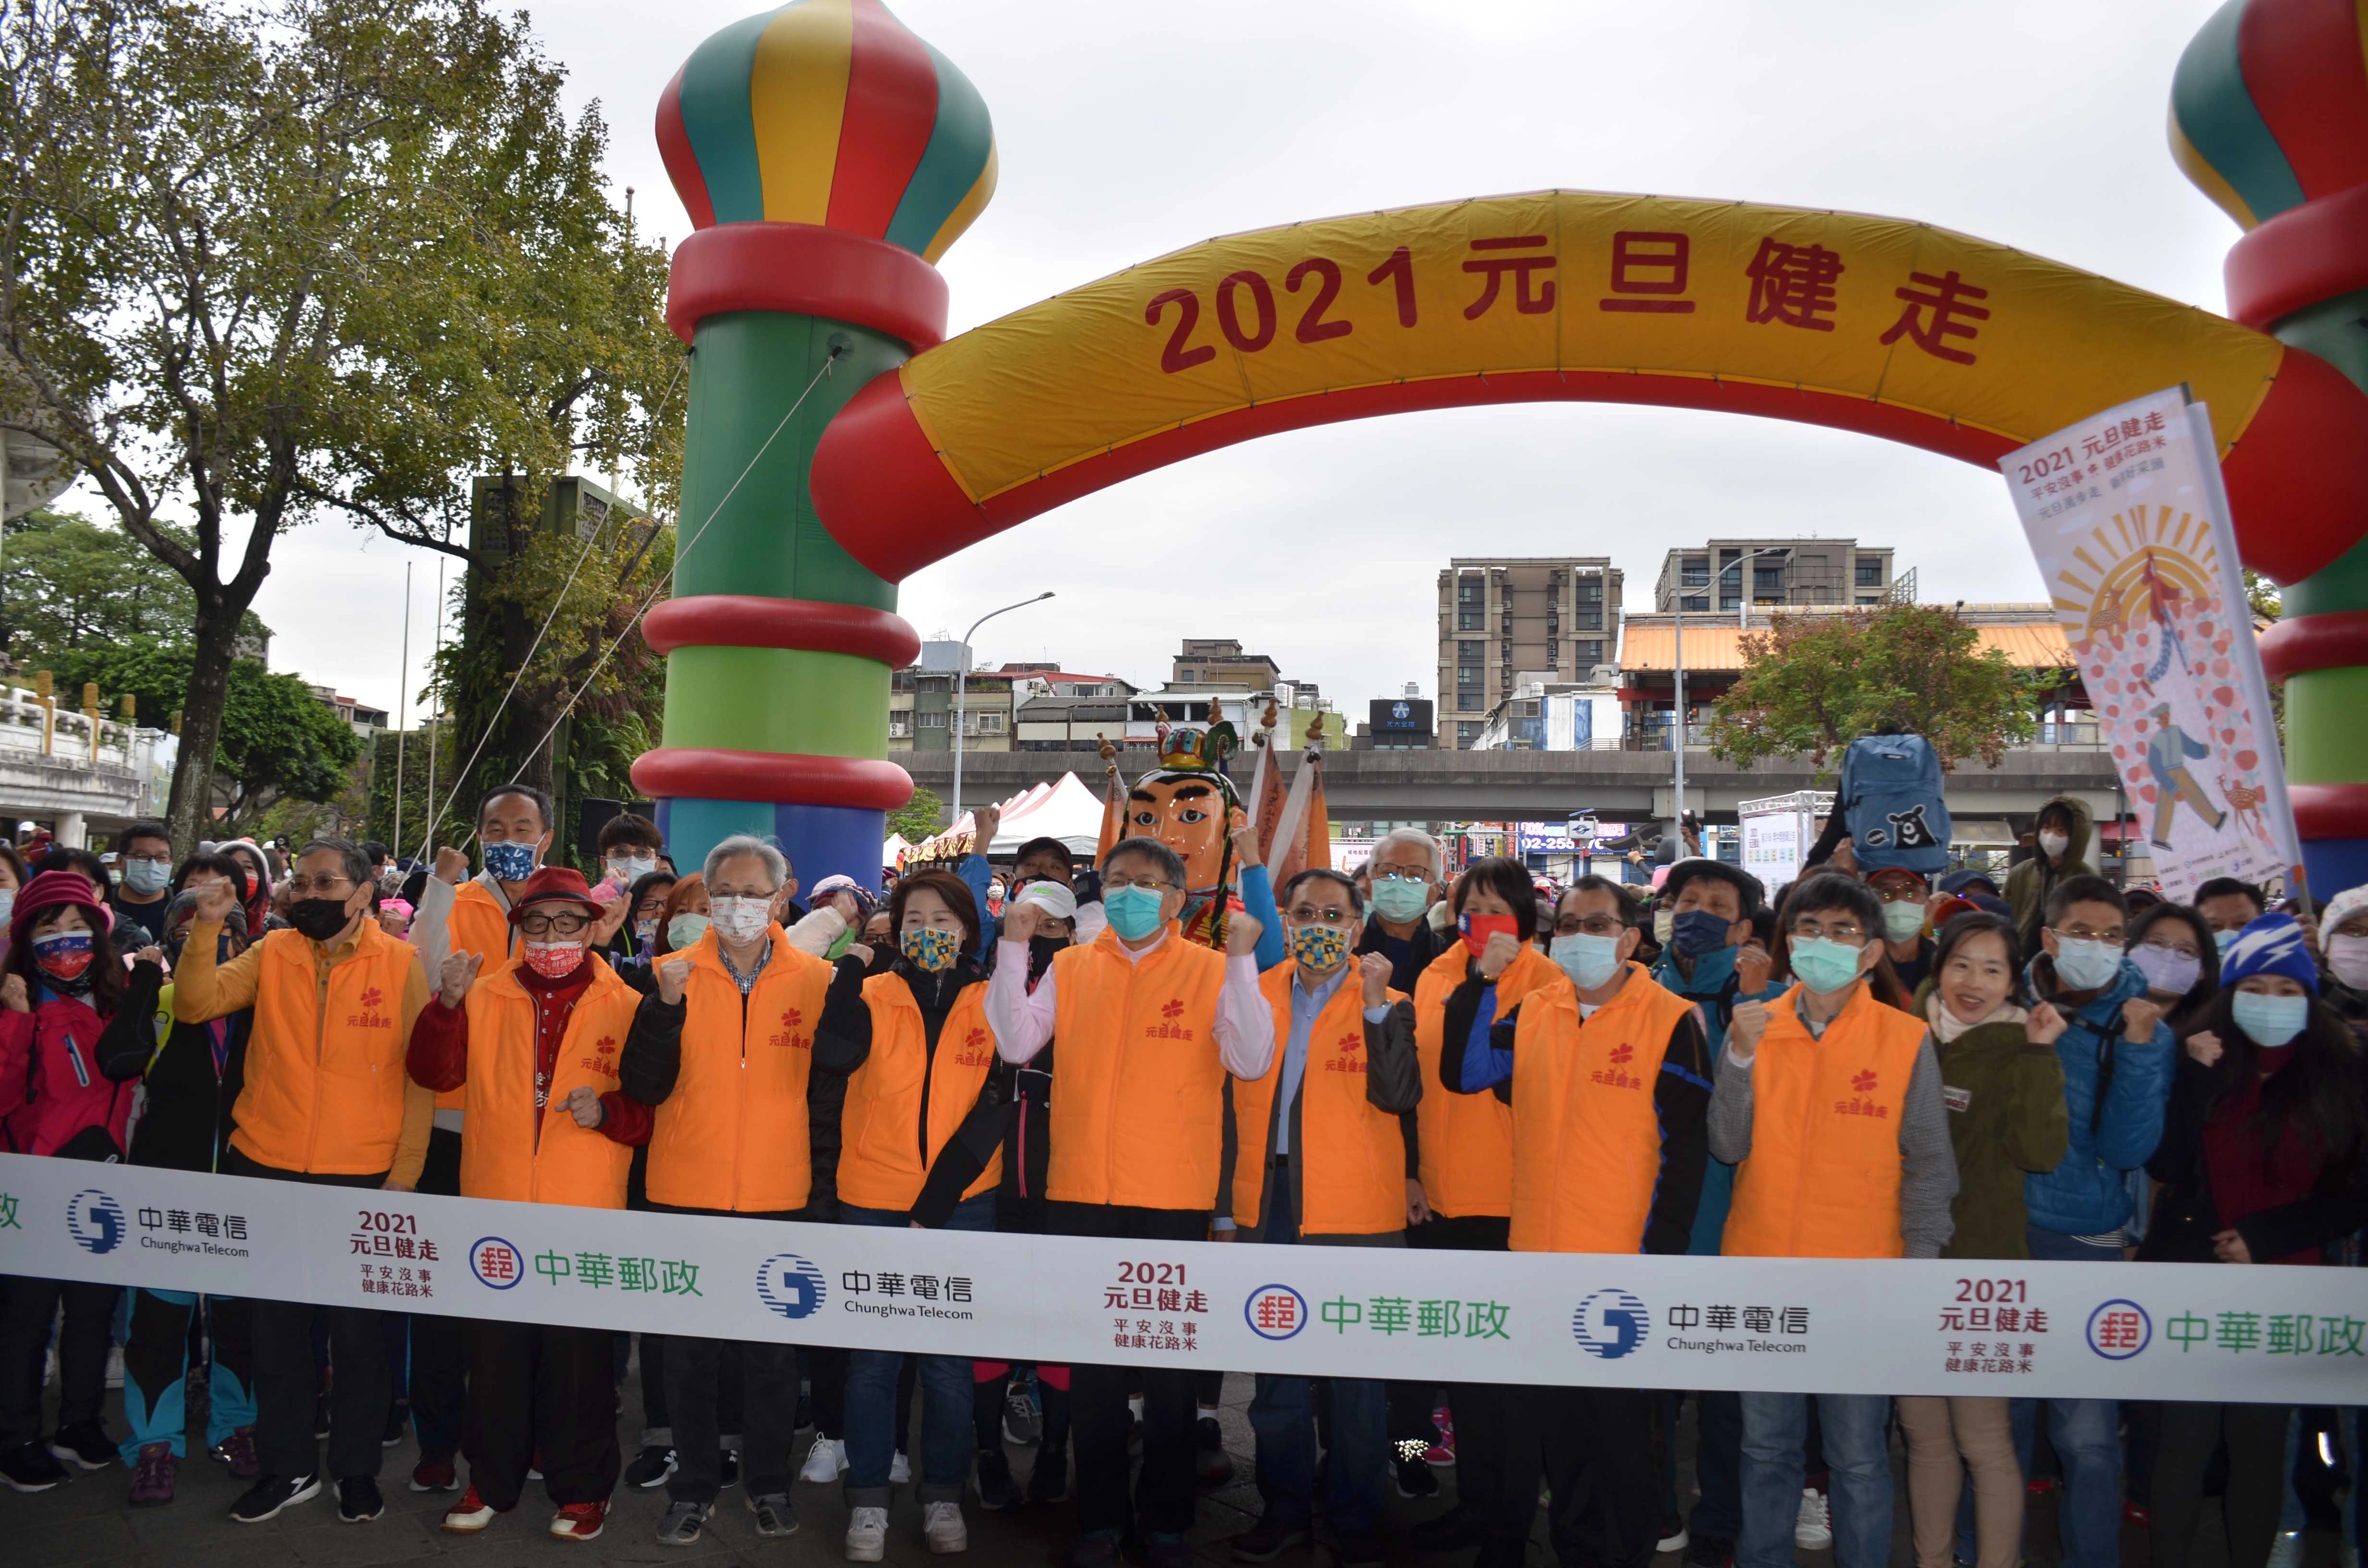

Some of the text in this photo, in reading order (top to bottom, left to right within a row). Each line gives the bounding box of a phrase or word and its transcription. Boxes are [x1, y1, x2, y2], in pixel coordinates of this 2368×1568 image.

[2019, 411, 2165, 484] 2021 元旦健走
[2030, 469, 2084, 500] 平安沒事
[139, 1207, 247, 1240] 中華電信
[358, 1211, 417, 1235] 2021
[141, 1236, 249, 1258] Chunghwa Telecom
[350, 1233, 439, 1261] 元旦健走
[360, 1264, 432, 1283] 平安沒事
[534, 1249, 703, 1297] 中華郵政
[1118, 1261, 1185, 1286] 2021
[362, 1278, 433, 1298] 健康花路米
[842, 1270, 973, 1302] 中華電信
[1955, 1278, 2026, 1303] 2021
[844, 1300, 973, 1320] Chunghwa Telecom
[1103, 1287, 1209, 1313] 元旦健走
[1113, 1318, 1197, 1335] 平安沒事
[1321, 1294, 1511, 1340] 中華郵政
[1669, 1303, 1810, 1334] 中華電信
[1938, 1307, 2048, 1333] 元旦健走
[1114, 1334, 1198, 1351] 健康花路米
[1667, 1337, 1806, 1354] Chunghwa Telecom
[2167, 1310, 2367, 1356] 中華郵政
[1946, 1341, 2035, 1358] 平安沒事
[1945, 1357, 2033, 1373] 健康花路米
